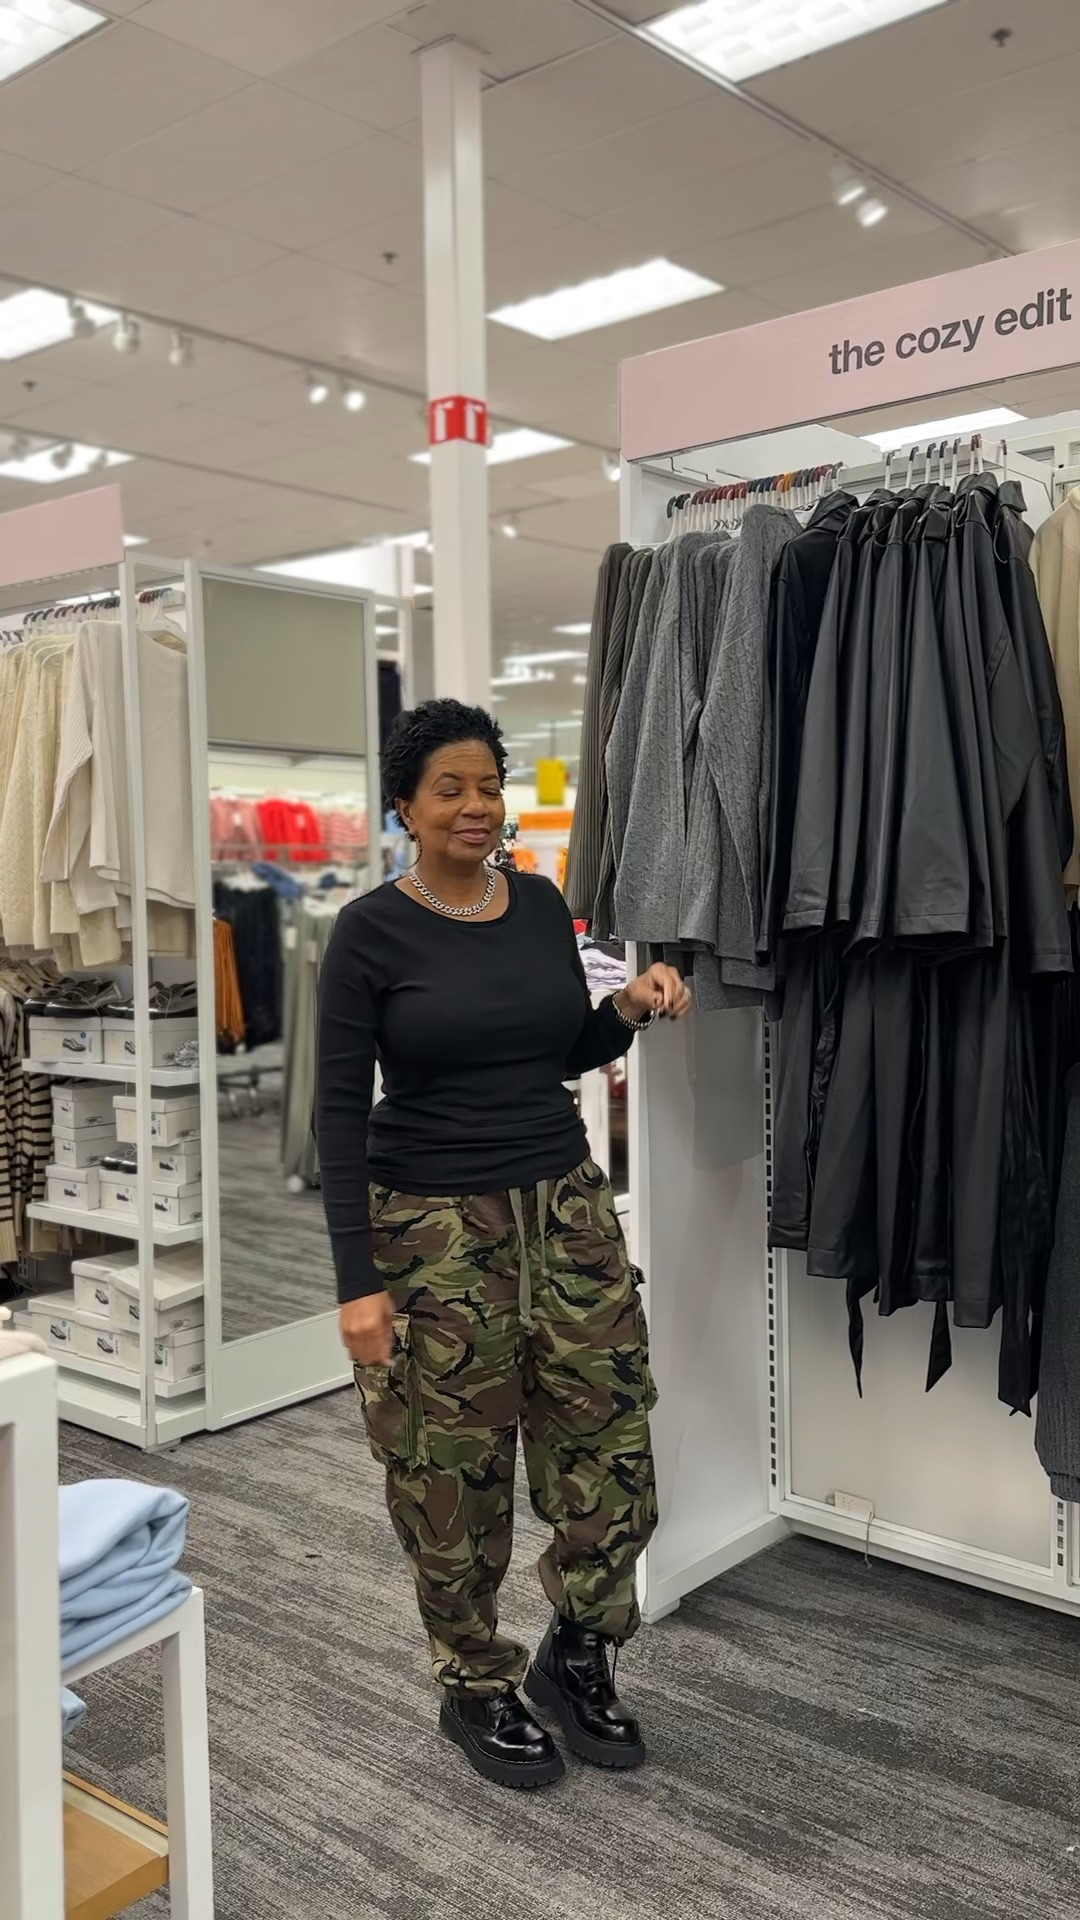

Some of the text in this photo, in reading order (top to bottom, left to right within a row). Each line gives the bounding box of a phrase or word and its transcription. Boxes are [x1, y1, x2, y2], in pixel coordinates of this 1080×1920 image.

[829, 288, 1072, 375] the cozy edit
